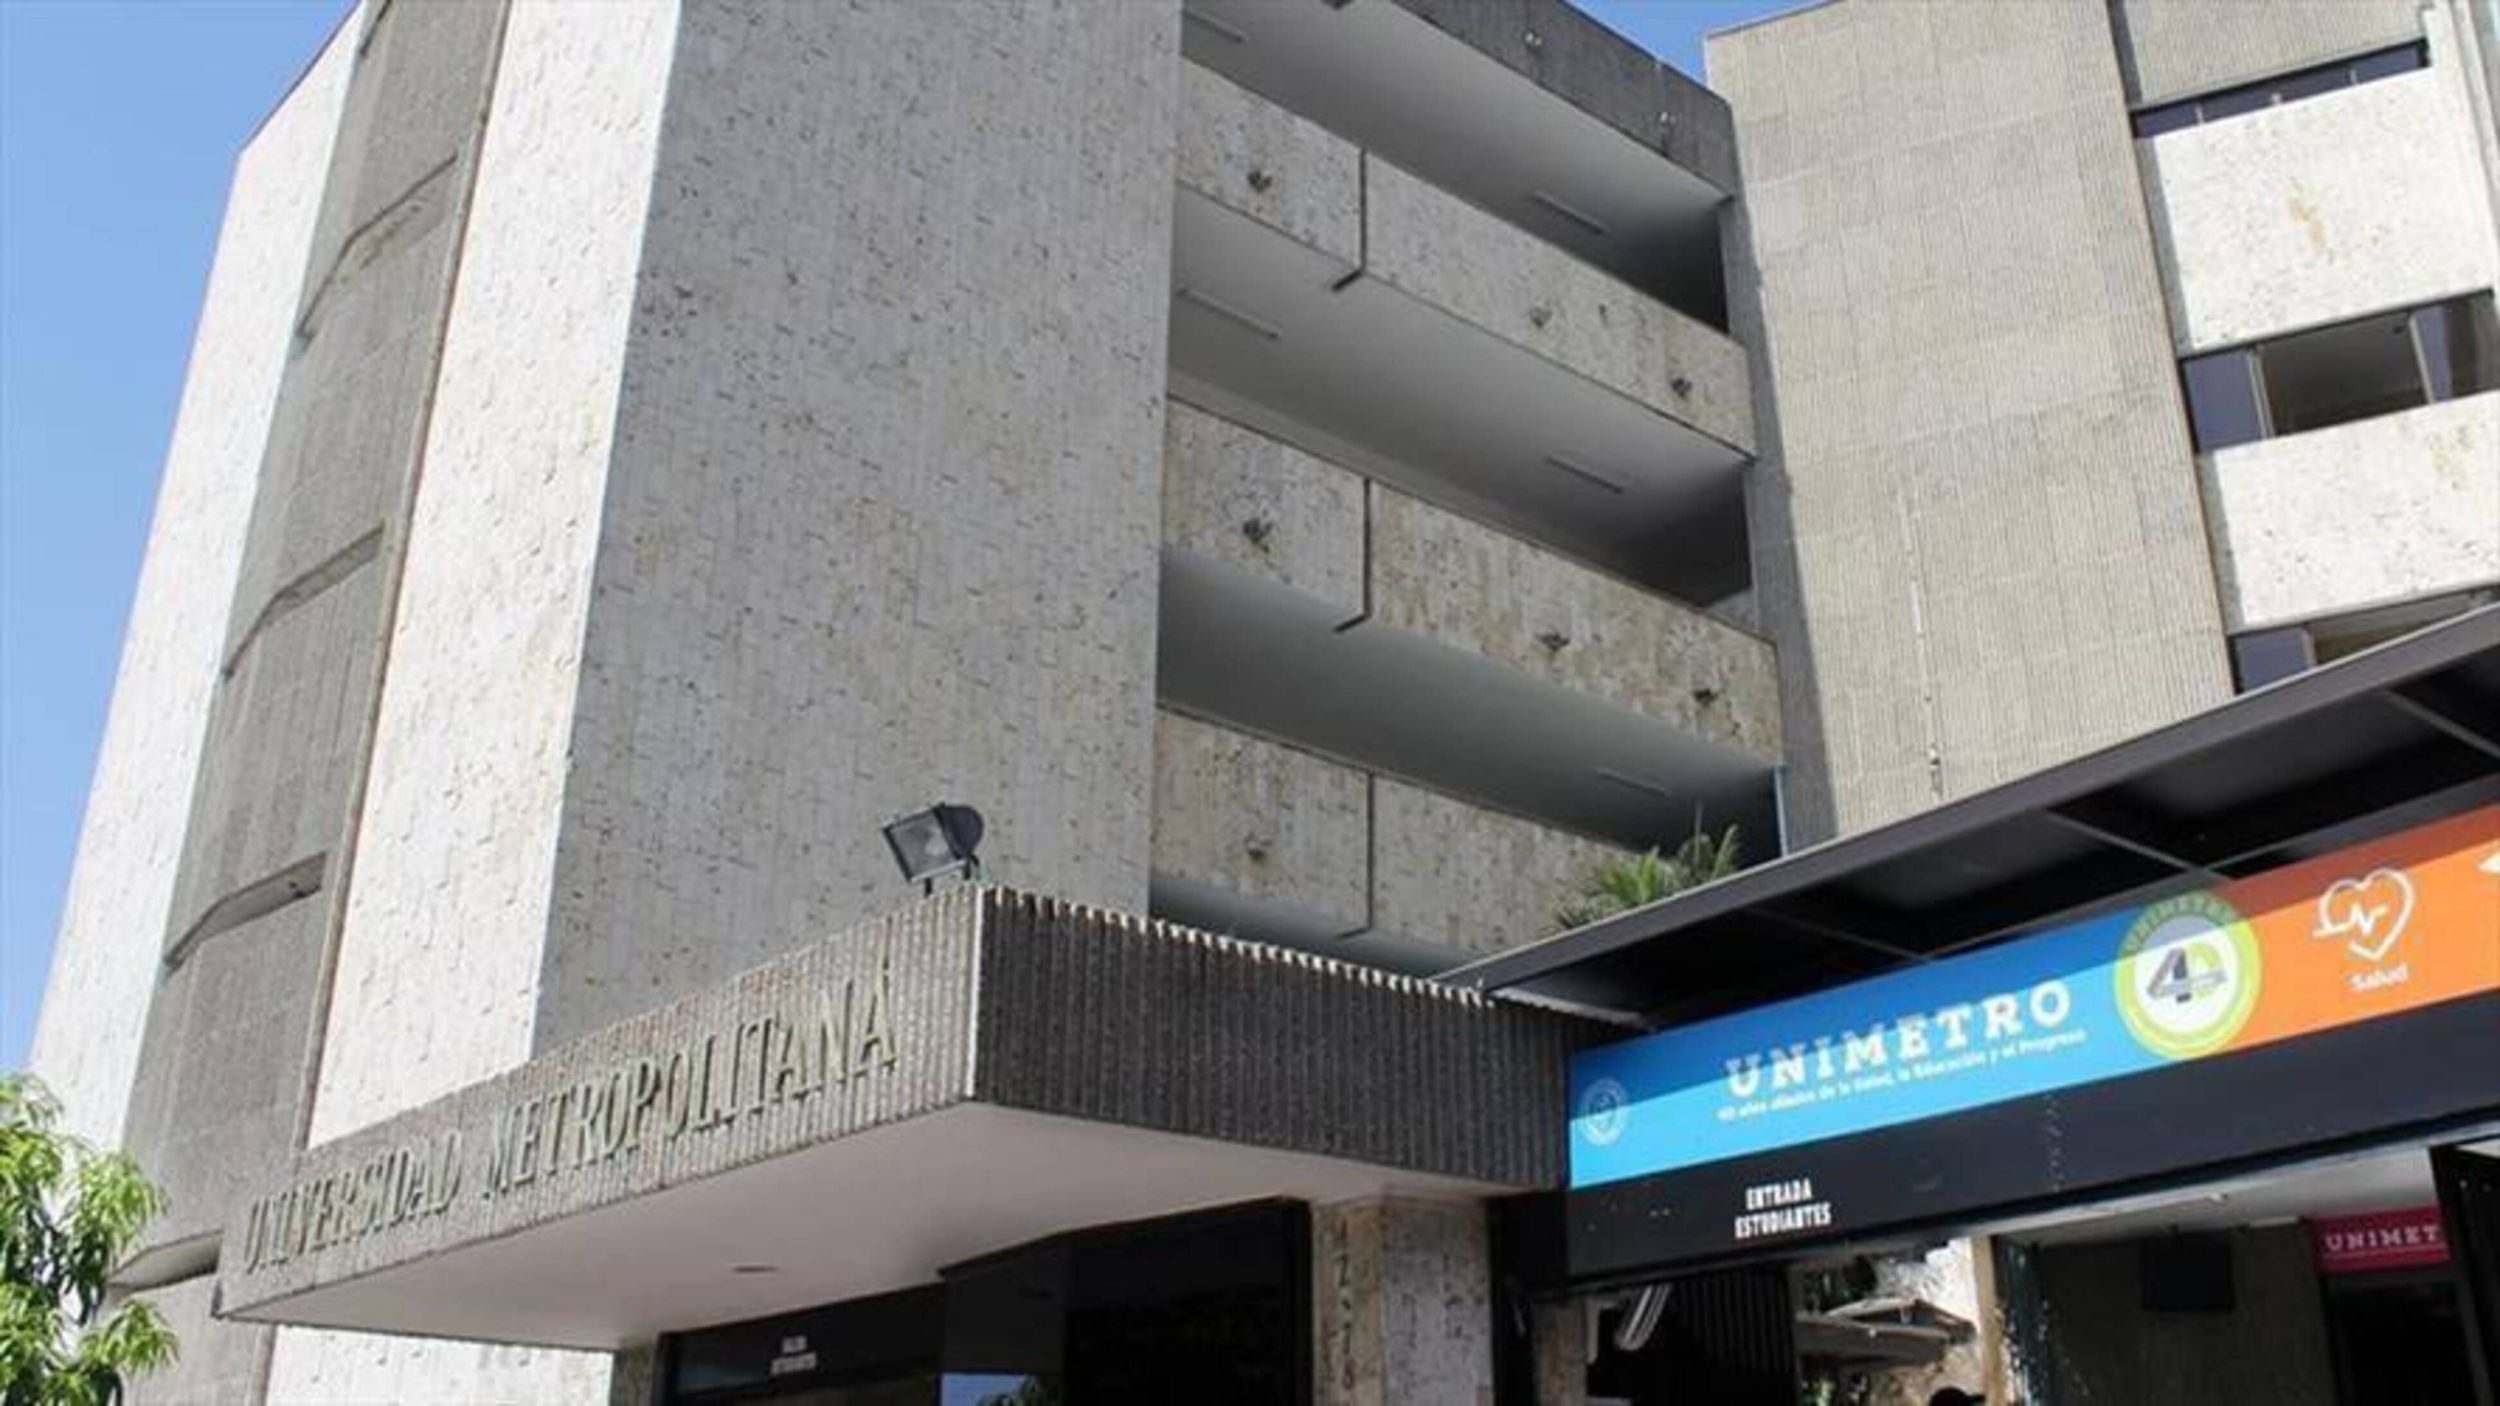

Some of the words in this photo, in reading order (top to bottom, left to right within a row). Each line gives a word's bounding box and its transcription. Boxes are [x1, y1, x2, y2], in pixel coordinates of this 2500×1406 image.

[2349, 961, 2408, 992] Salud
[1725, 979, 2071, 1098] UNIMETRO
[245, 1130, 462, 1275] UNIVERSIDAD
[483, 966, 898, 1202] METROPOLITANA
[1746, 1178, 1812, 1210] ENTRADA
[1734, 1202, 1832, 1239] ESTUDIANTES
